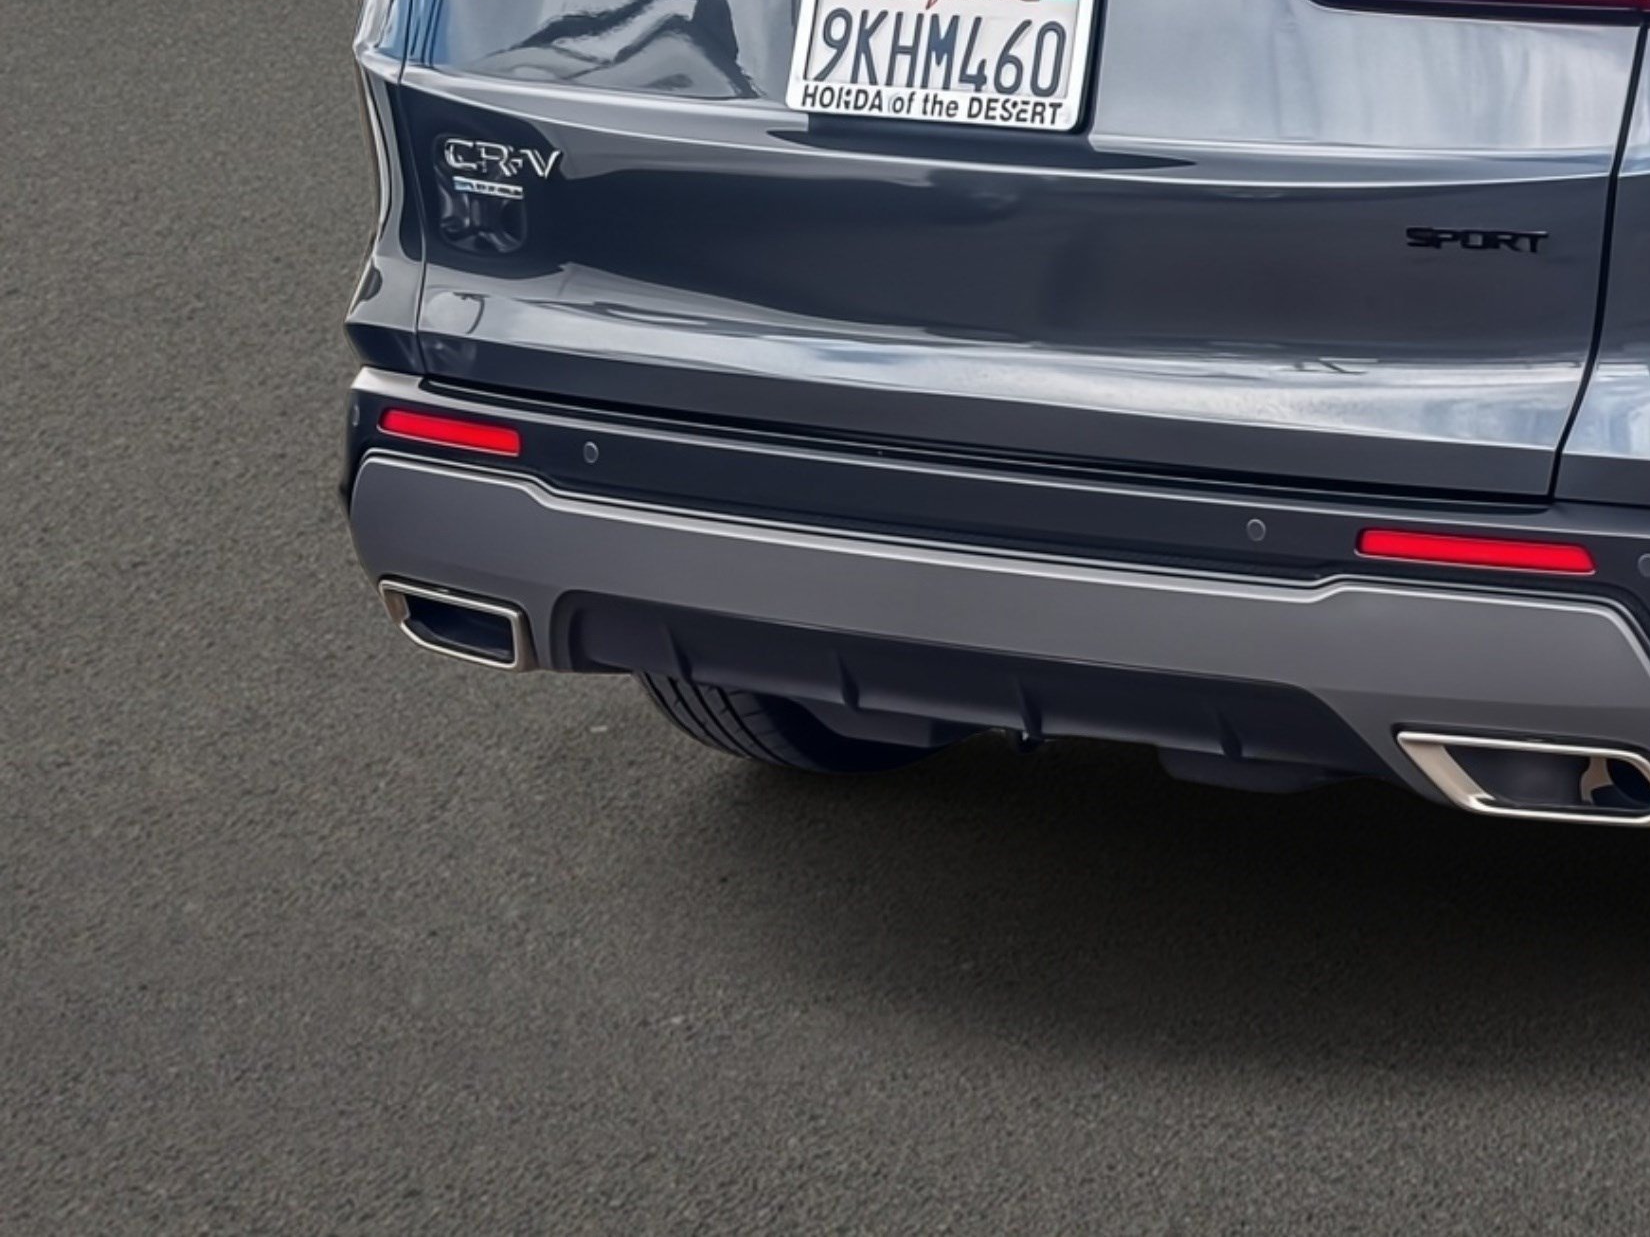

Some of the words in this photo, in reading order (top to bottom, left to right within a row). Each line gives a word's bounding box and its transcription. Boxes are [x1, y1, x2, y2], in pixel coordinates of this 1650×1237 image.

[813, 7, 1067, 98] 9KHM460
[801, 84, 884, 112] HONDA
[891, 91, 913, 114] of
[922, 93, 959, 118] the
[966, 97, 1063, 126] DESERT
[444, 138, 562, 179] CR-V
[1406, 227, 1549, 254] SPORT
